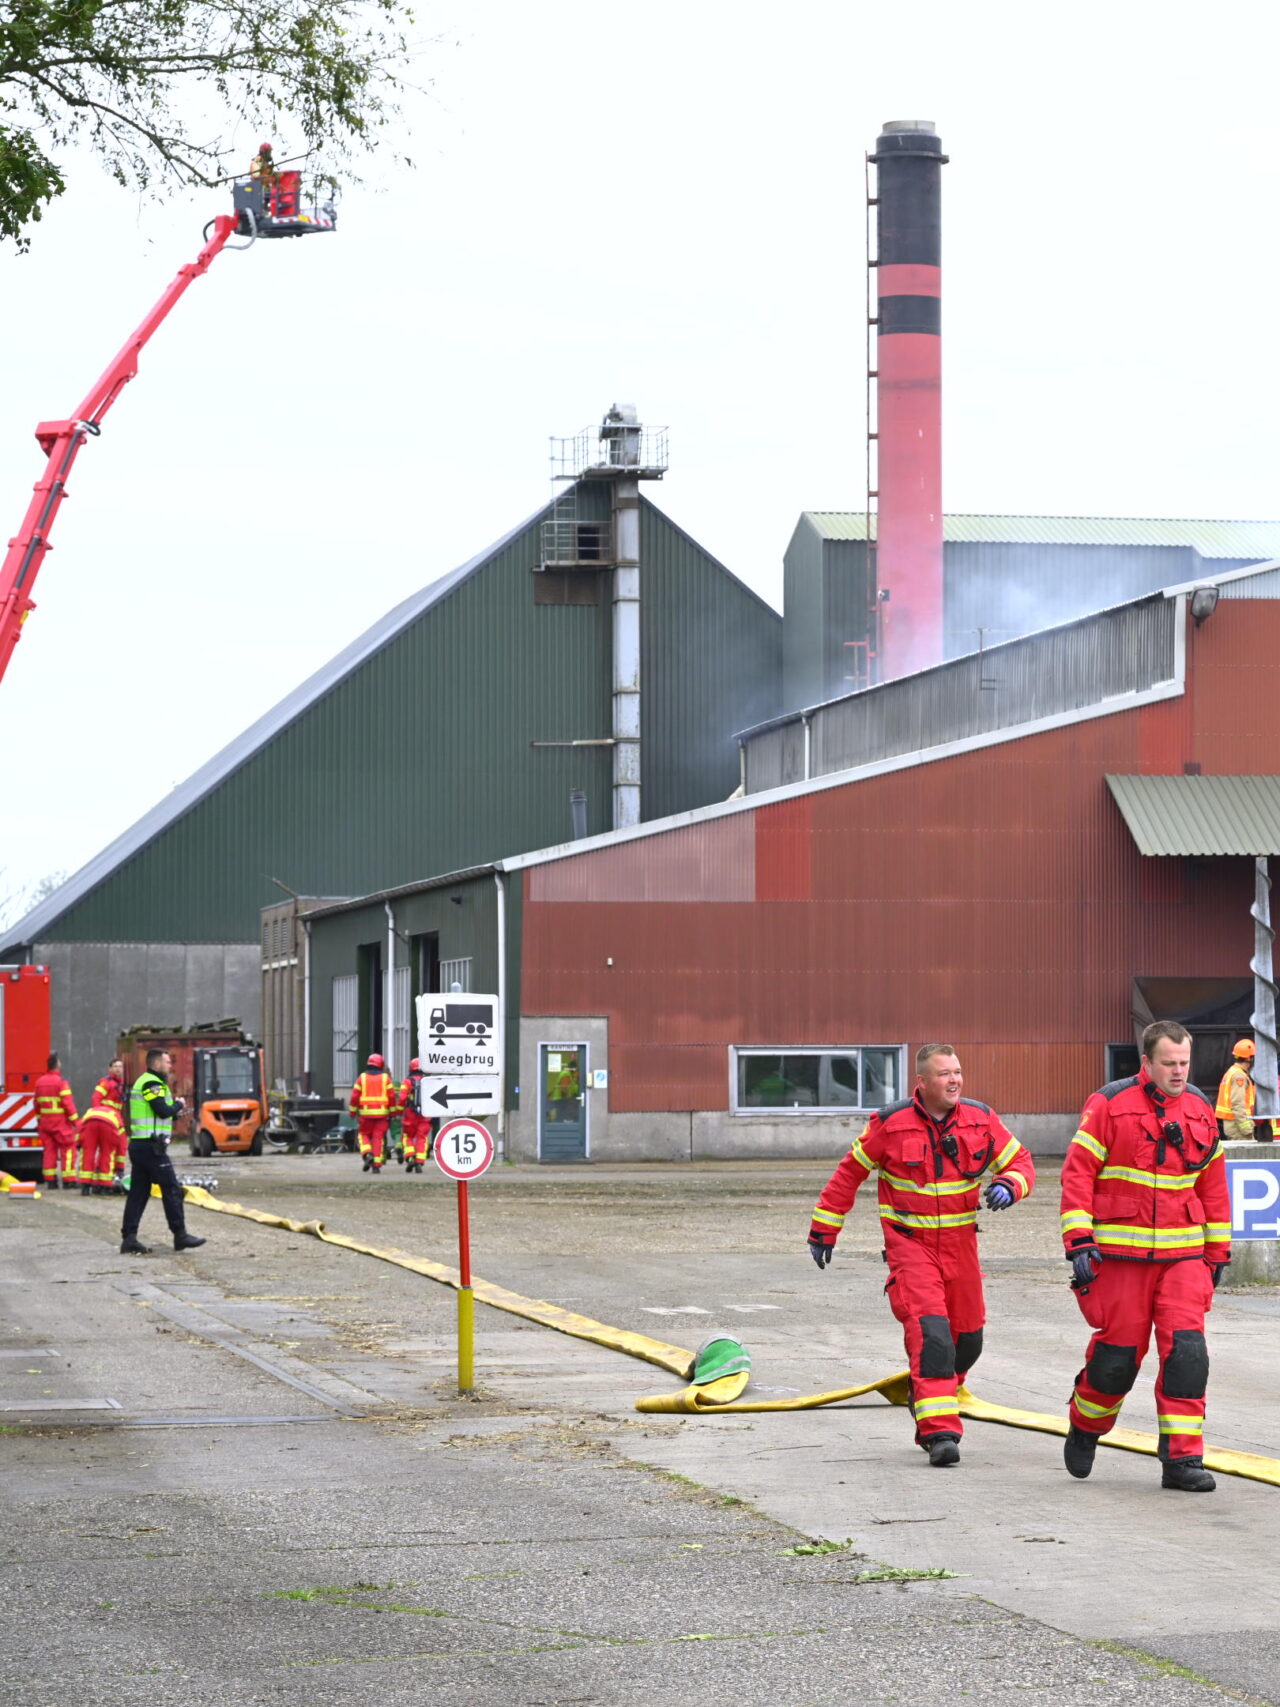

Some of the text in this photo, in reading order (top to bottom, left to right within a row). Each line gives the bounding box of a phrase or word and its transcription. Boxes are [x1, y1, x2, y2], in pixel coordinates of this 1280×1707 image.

[429, 1053, 494, 1067] Weegbrug
[451, 1133, 477, 1154] 15
[457, 1154, 472, 1165] km
[1232, 1168, 1280, 1232] P
